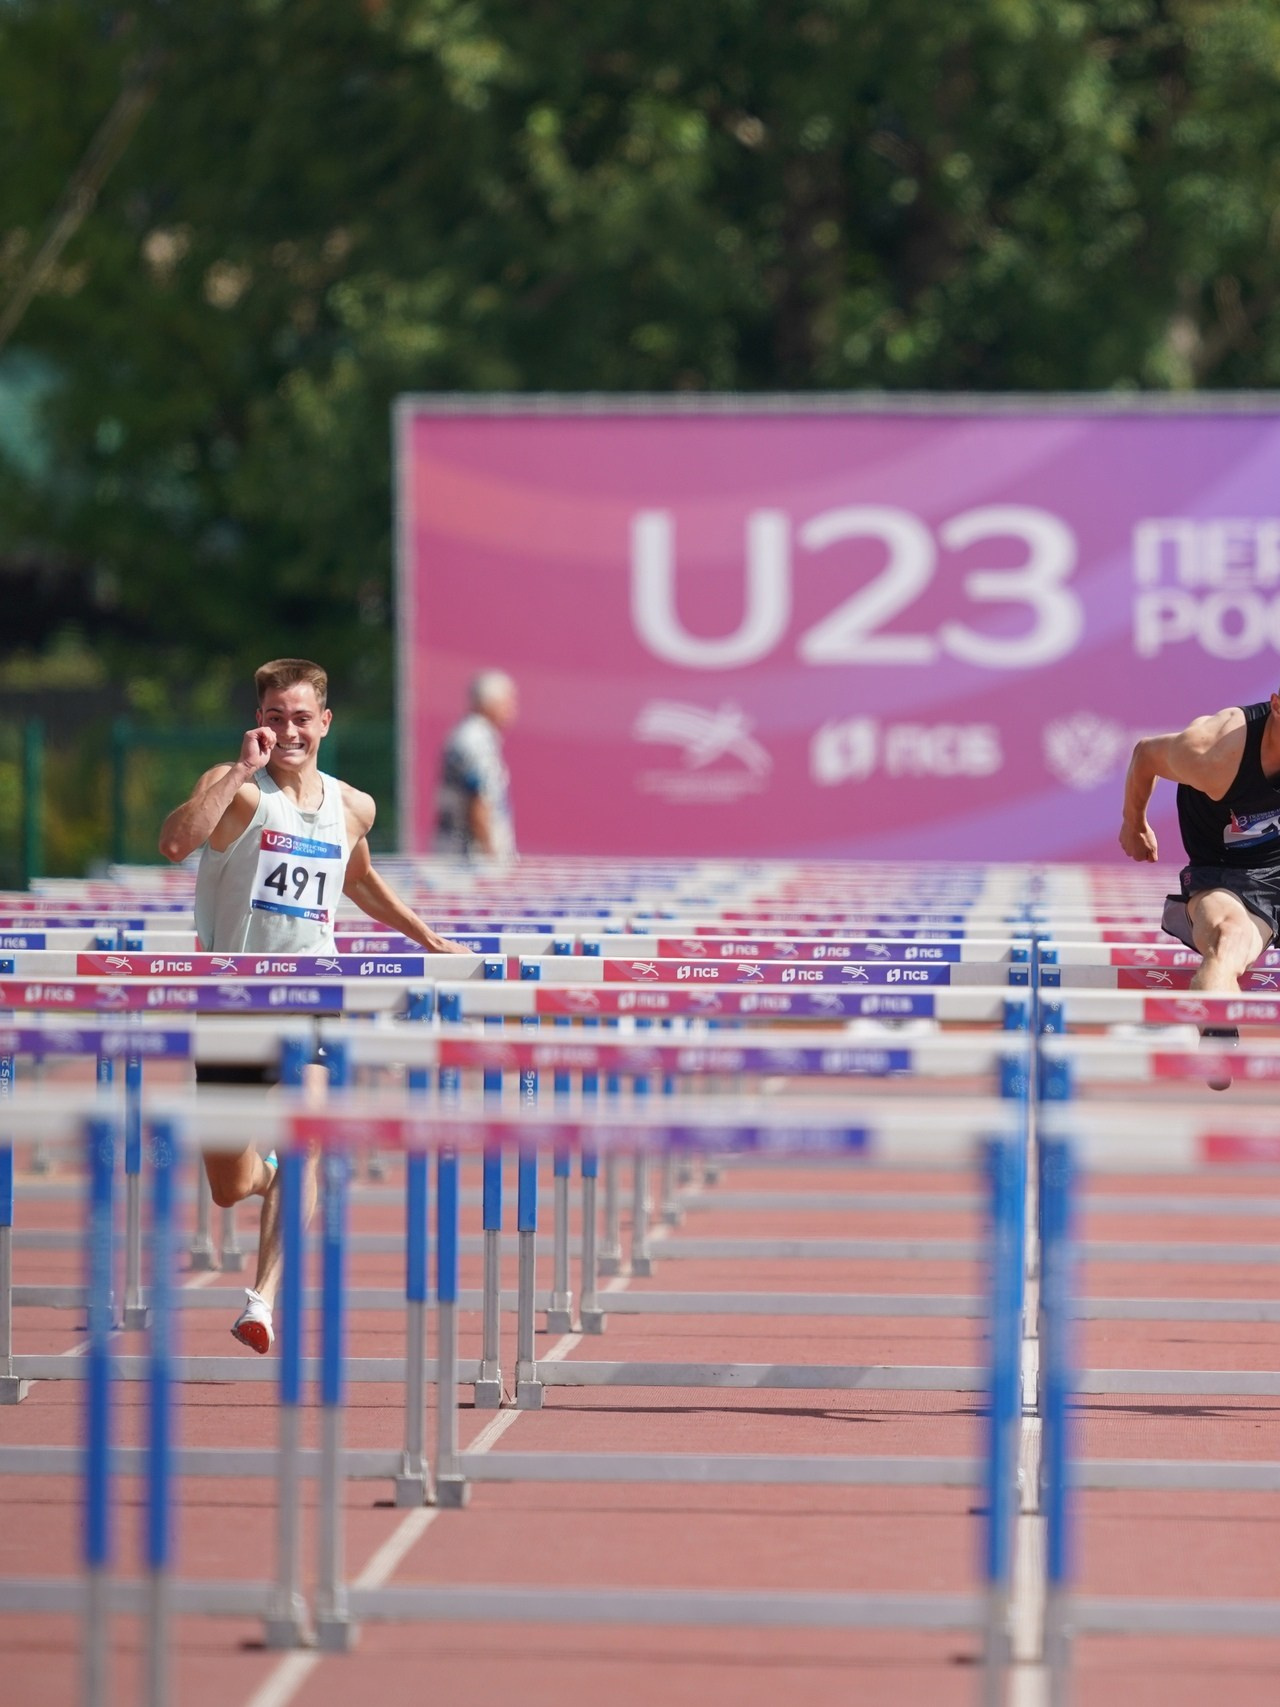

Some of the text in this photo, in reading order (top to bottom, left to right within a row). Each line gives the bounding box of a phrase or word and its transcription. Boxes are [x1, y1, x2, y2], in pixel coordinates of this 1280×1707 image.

[630, 505, 1084, 669] U23
[266, 833, 293, 849] U23
[264, 861, 327, 906] 491
[167, 961, 402, 974] ПСБ ПСБ ПСБ
[693, 967, 929, 981] ПСБ ПСБ ПСБ
